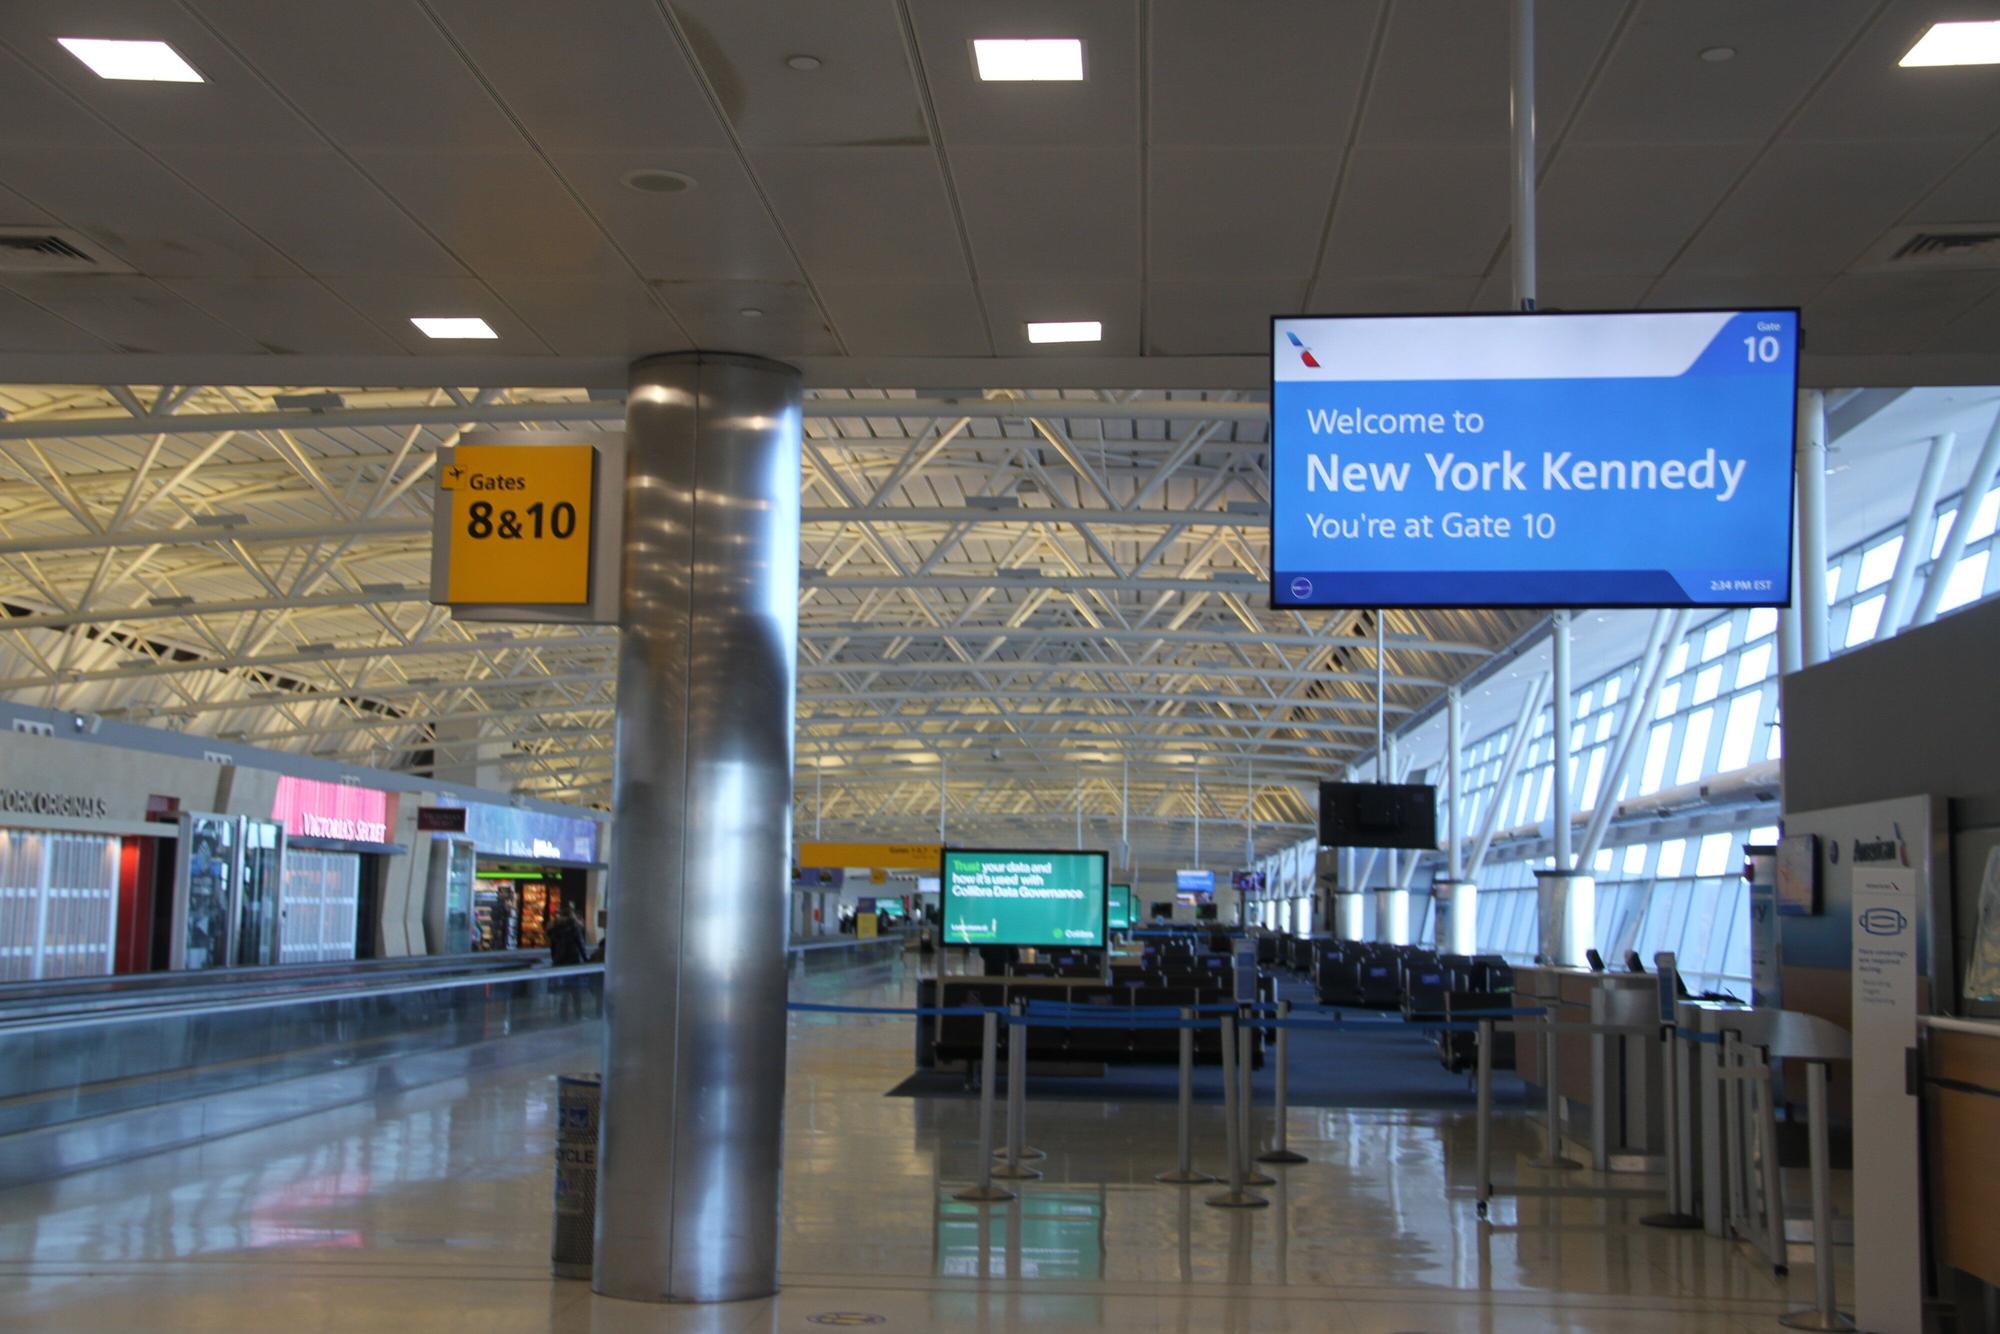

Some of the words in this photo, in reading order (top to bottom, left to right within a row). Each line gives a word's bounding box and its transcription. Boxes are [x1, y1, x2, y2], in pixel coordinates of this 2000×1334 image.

[1757, 321, 1781, 332] Gate
[1744, 335, 1780, 363] 10
[1306, 407, 1445, 434] Welcome
[1453, 410, 1484, 433] to
[469, 473, 526, 490] Gates
[1307, 453, 1411, 492] New
[1424, 449, 1527, 491] York
[1543, 447, 1747, 502] Kennedy
[467, 501, 577, 539] 8&10
[1306, 513, 1396, 539] You're
[1404, 515, 1434, 538] at
[1442, 512, 1511, 538] Gate
[1522, 512, 1556, 539] 10
[1710, 580, 1733, 591] 2:34
[1734, 580, 1752, 591] PM
[1753, 580, 1772, 591] EST
[953, 859, 981, 872] Trust
[981, 862, 1006, 875] your
[1006, 861, 1031, 873] data
[1031, 862, 1053, 874] and
[952, 872, 976, 885] how
[992, 873, 1018, 885] used
[1020, 873, 1045, 886] with
[993, 885, 1018, 898] Data
